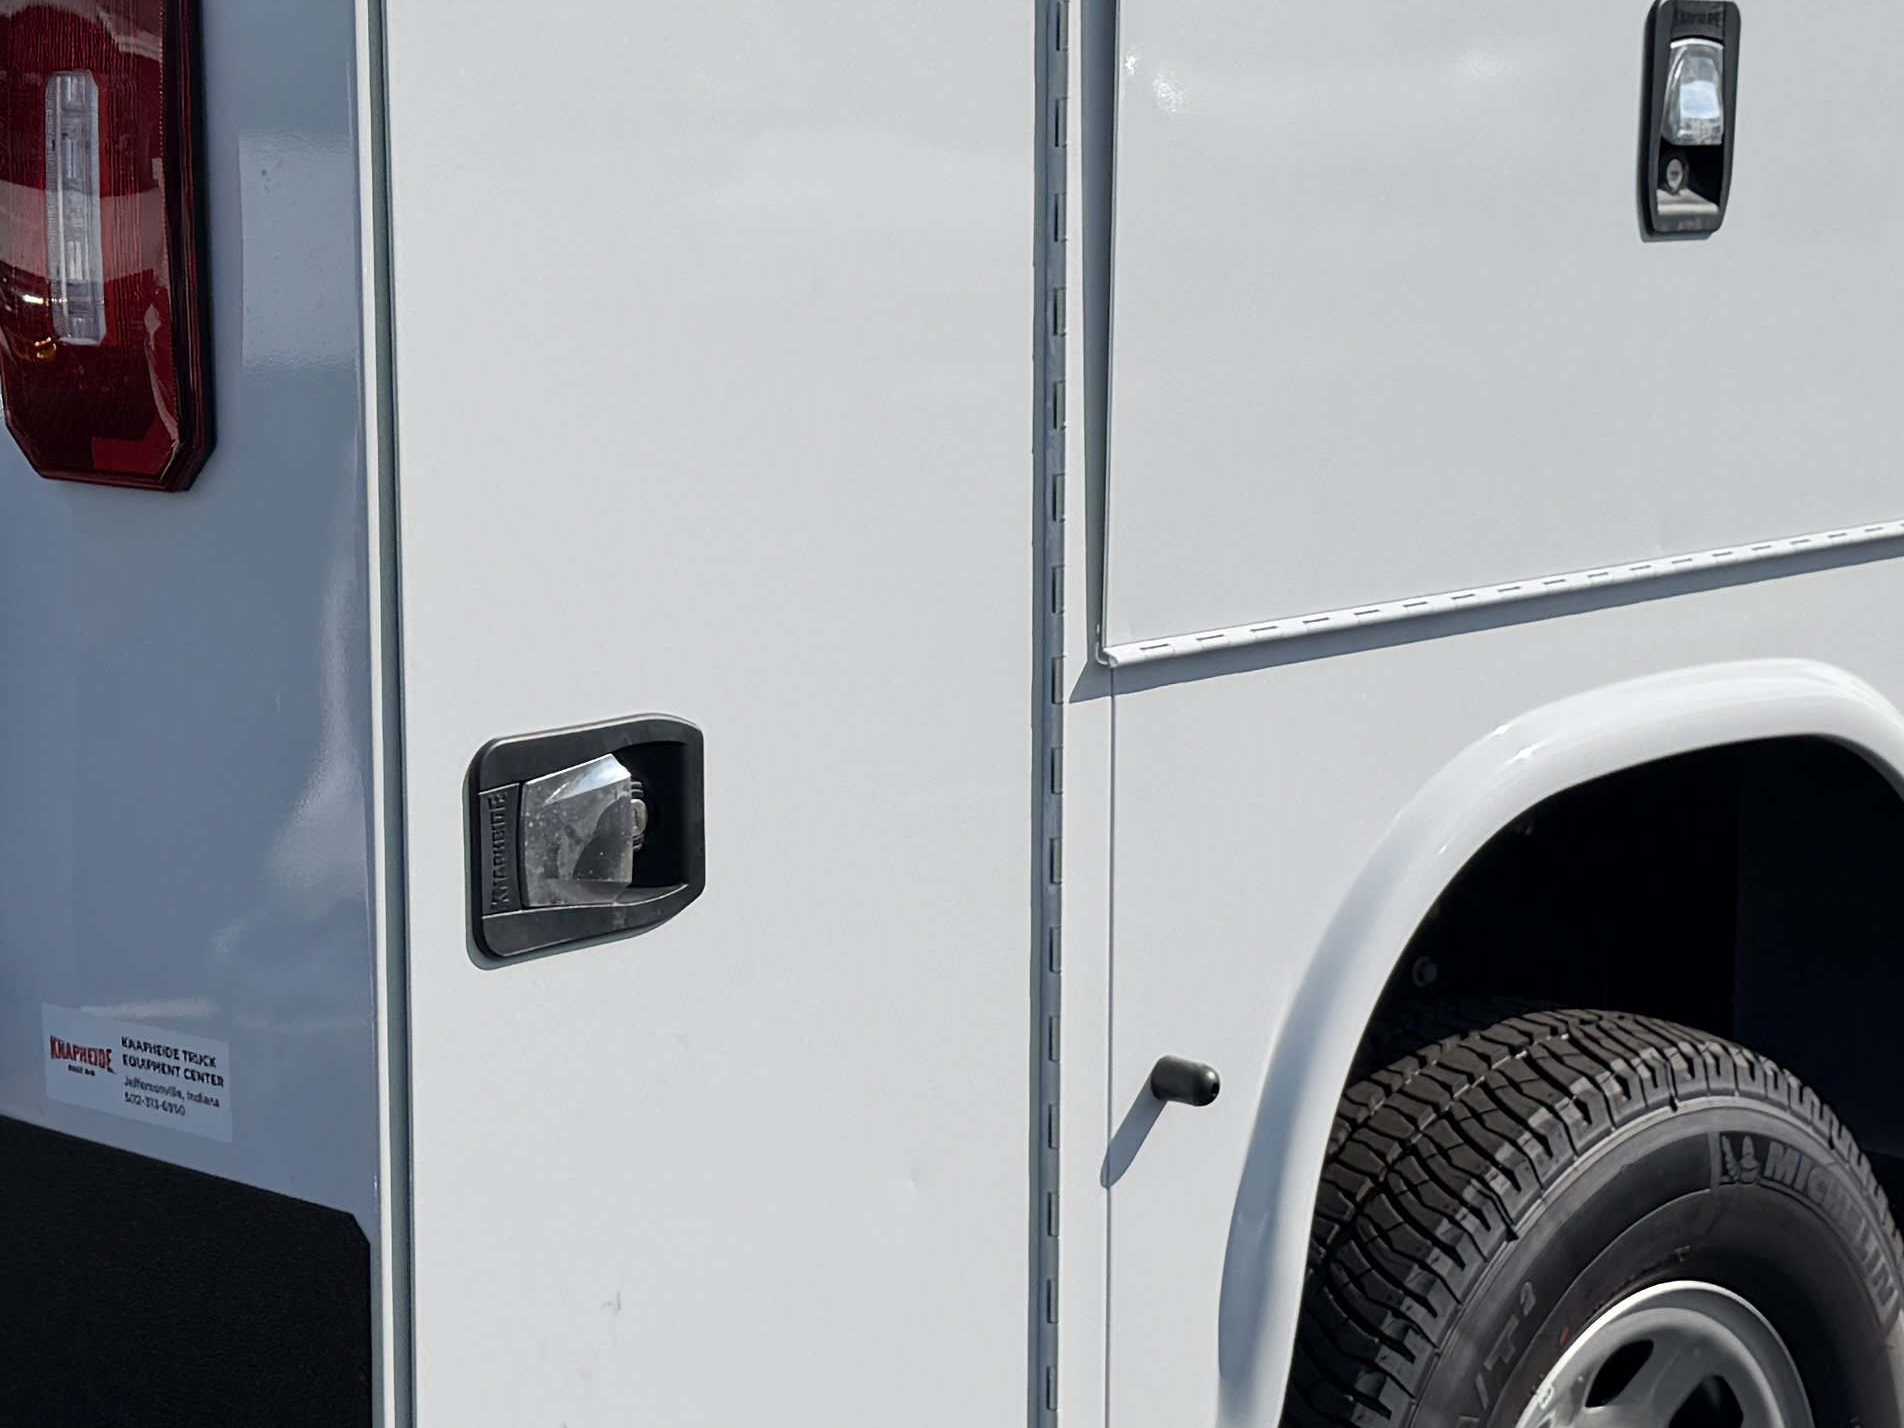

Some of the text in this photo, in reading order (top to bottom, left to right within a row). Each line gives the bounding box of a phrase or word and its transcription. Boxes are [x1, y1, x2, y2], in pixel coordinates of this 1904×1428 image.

[49, 1034, 115, 1074] KNAPHEIDE
[121, 1035, 217, 1069] KNAPHEIDE TRUCK
[122, 1053, 182, 1079] EQUIPMENT
[184, 1067, 224, 1088] CENTER
[1763, 1140, 1899, 1324] MICHELIN
